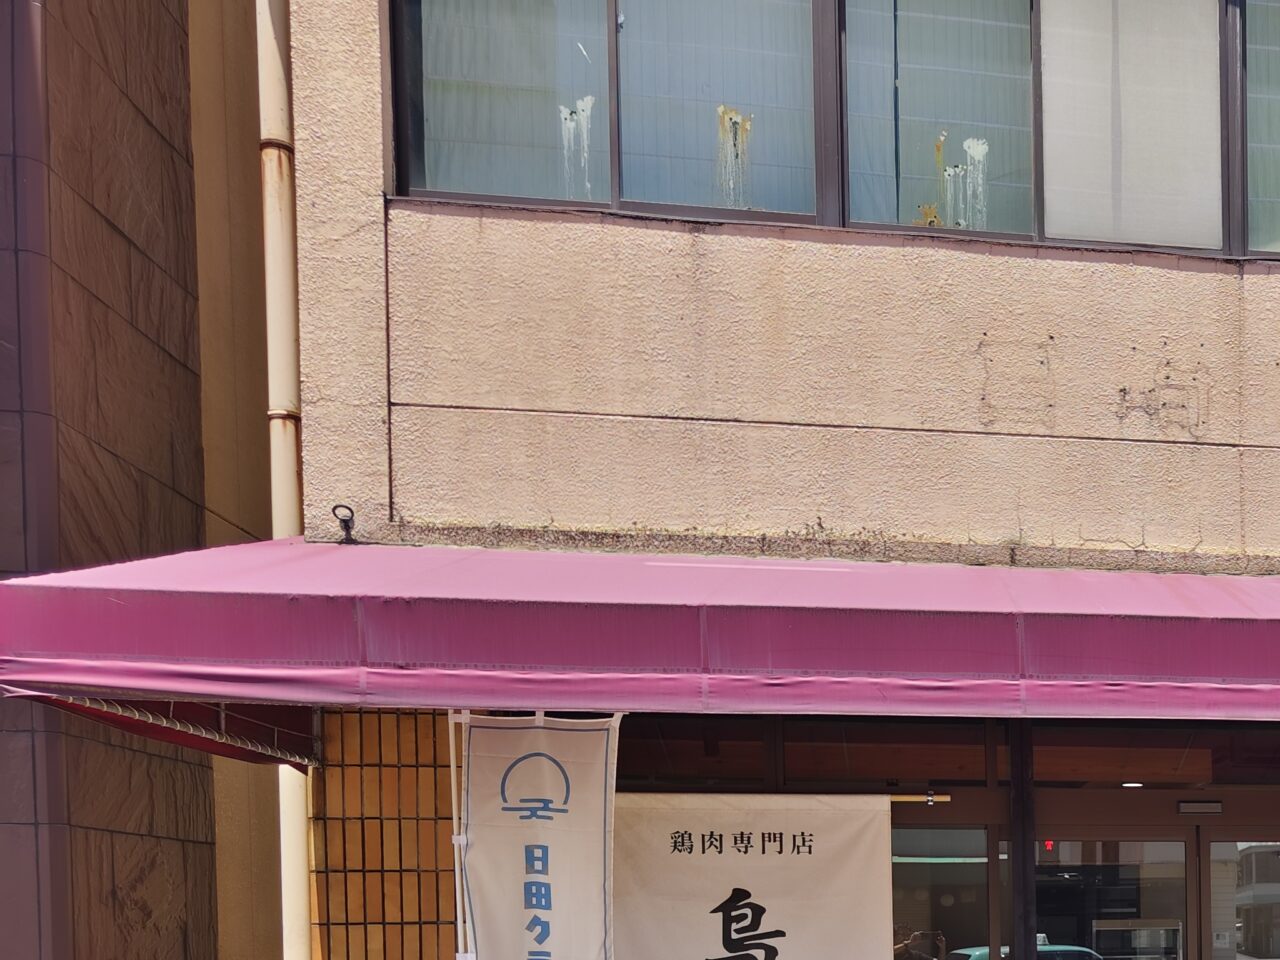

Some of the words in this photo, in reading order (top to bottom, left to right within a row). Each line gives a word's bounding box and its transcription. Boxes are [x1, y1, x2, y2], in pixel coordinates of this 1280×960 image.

[669, 830, 816, 856] 鶏肉専門店
